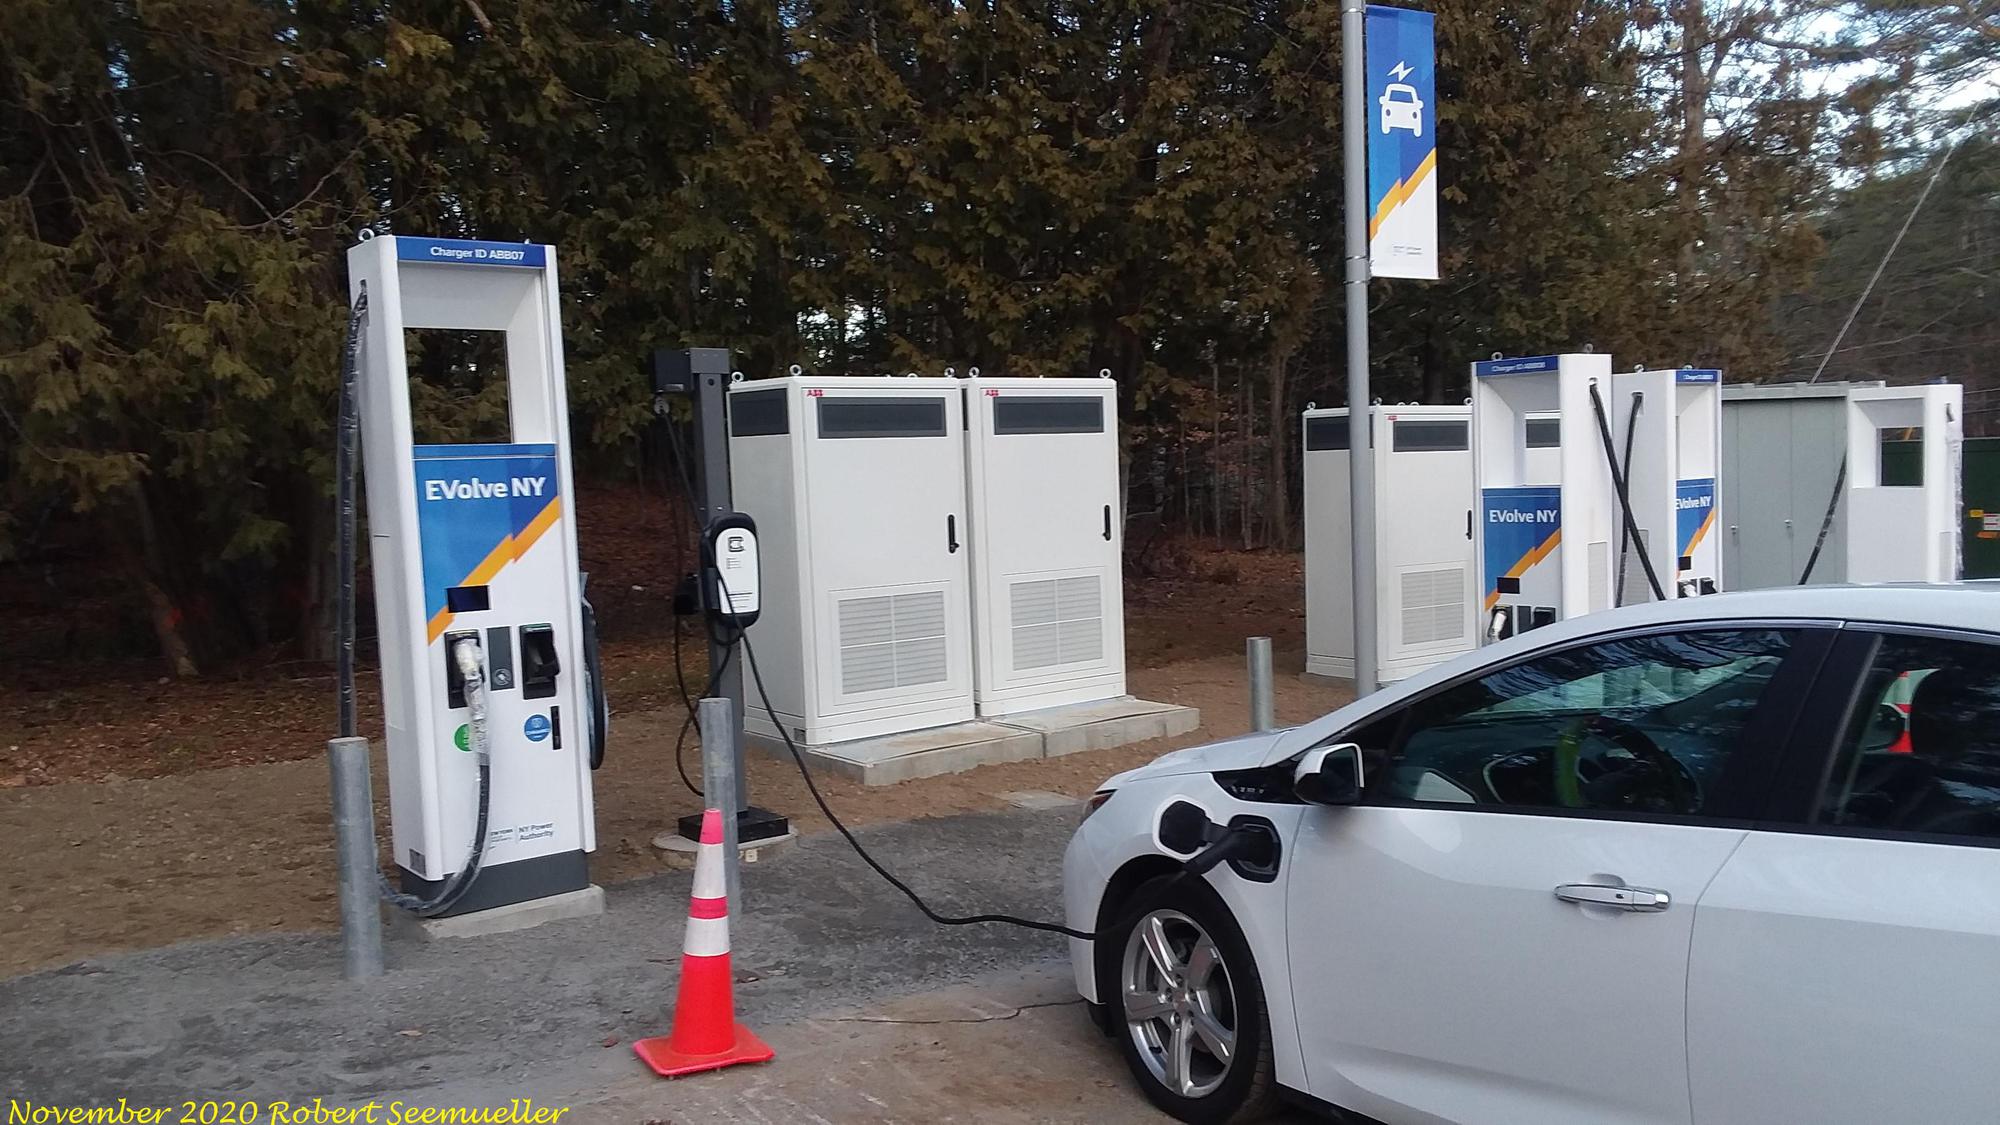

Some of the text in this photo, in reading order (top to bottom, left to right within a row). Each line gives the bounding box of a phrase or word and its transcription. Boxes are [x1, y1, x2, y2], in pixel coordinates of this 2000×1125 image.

[430, 246, 525, 261] Charger ID ABB07
[425, 476, 546, 501] EVolve NY
[1700, 495, 1711, 507] NY
[1489, 508, 1558, 523] EVolve NY
[531, 822, 553, 831] Power
[520, 830, 553, 841] Authority
